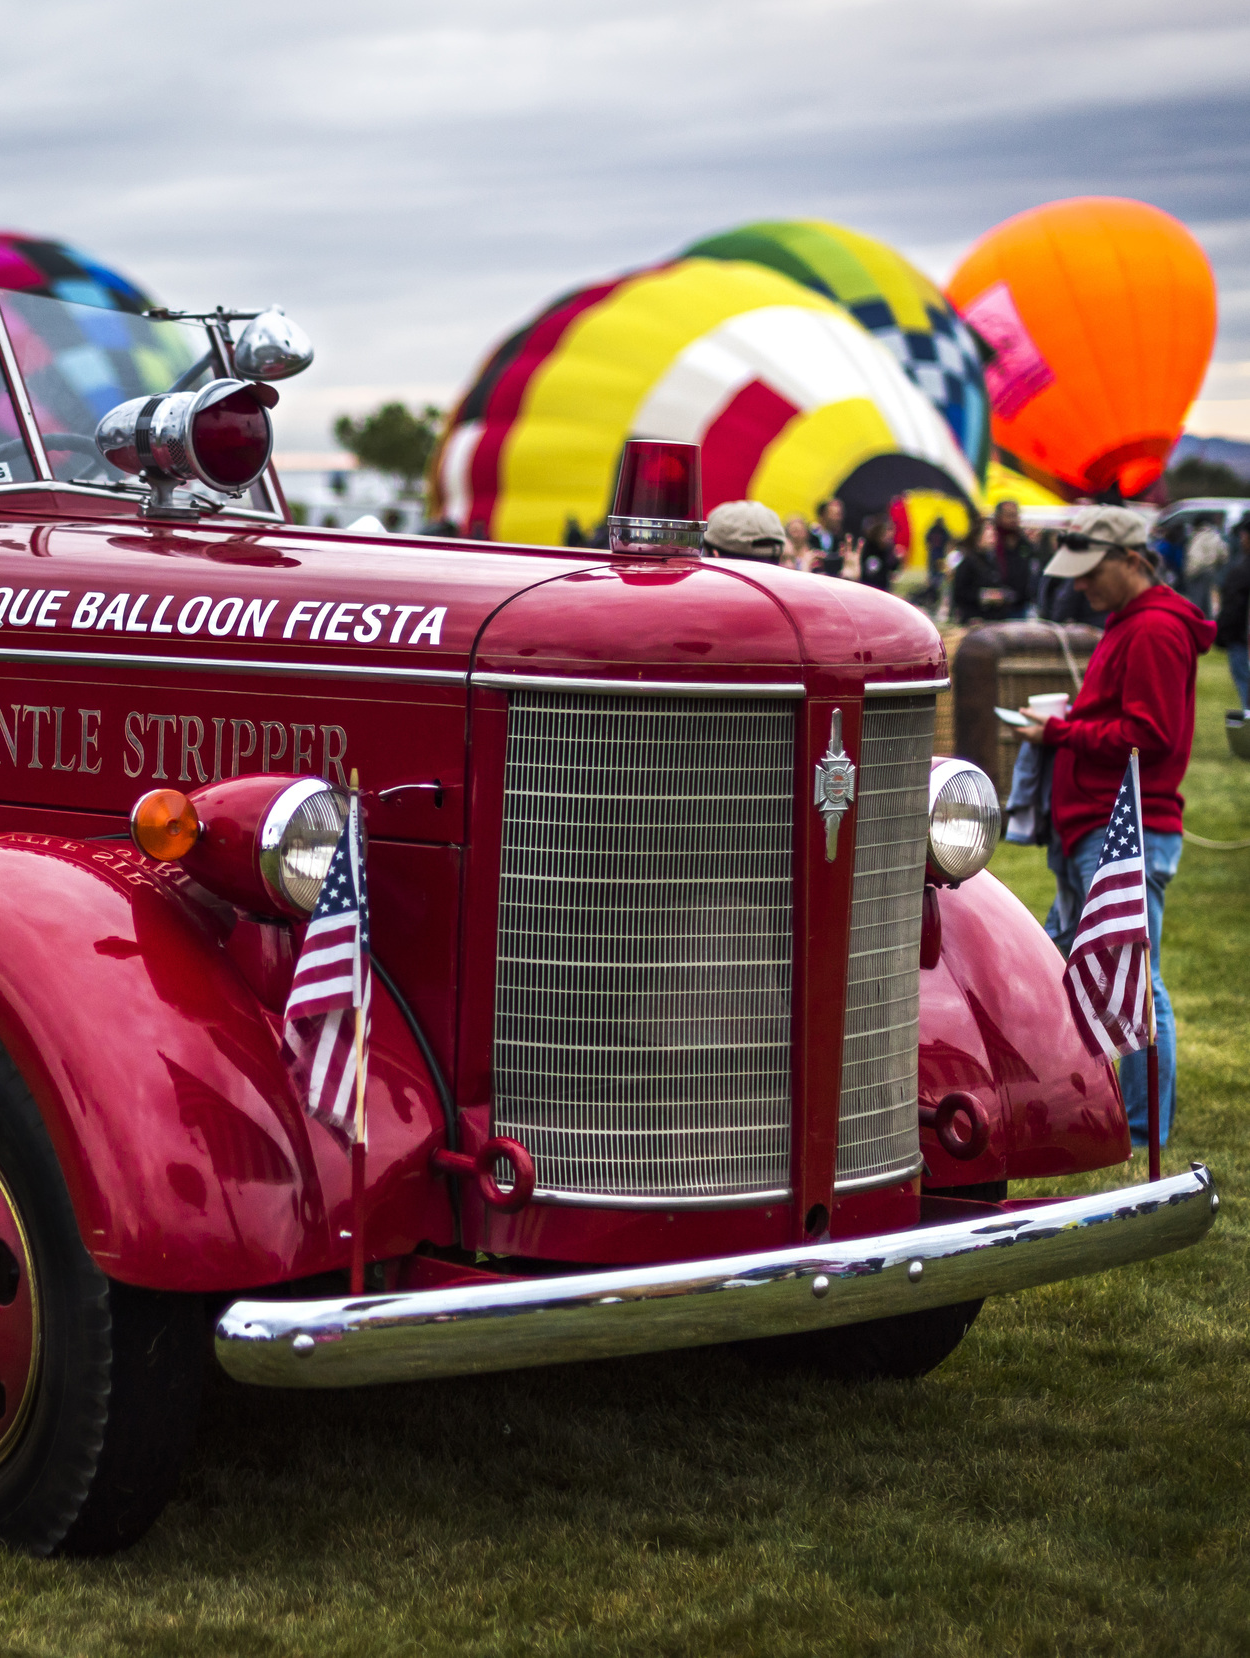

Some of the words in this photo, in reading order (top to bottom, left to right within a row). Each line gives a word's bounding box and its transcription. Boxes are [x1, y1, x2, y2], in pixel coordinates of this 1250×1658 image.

[71, 591, 279, 637] BALLOON
[282, 600, 448, 645] FIESTA
[123, 710, 351, 789] STRIPPER
